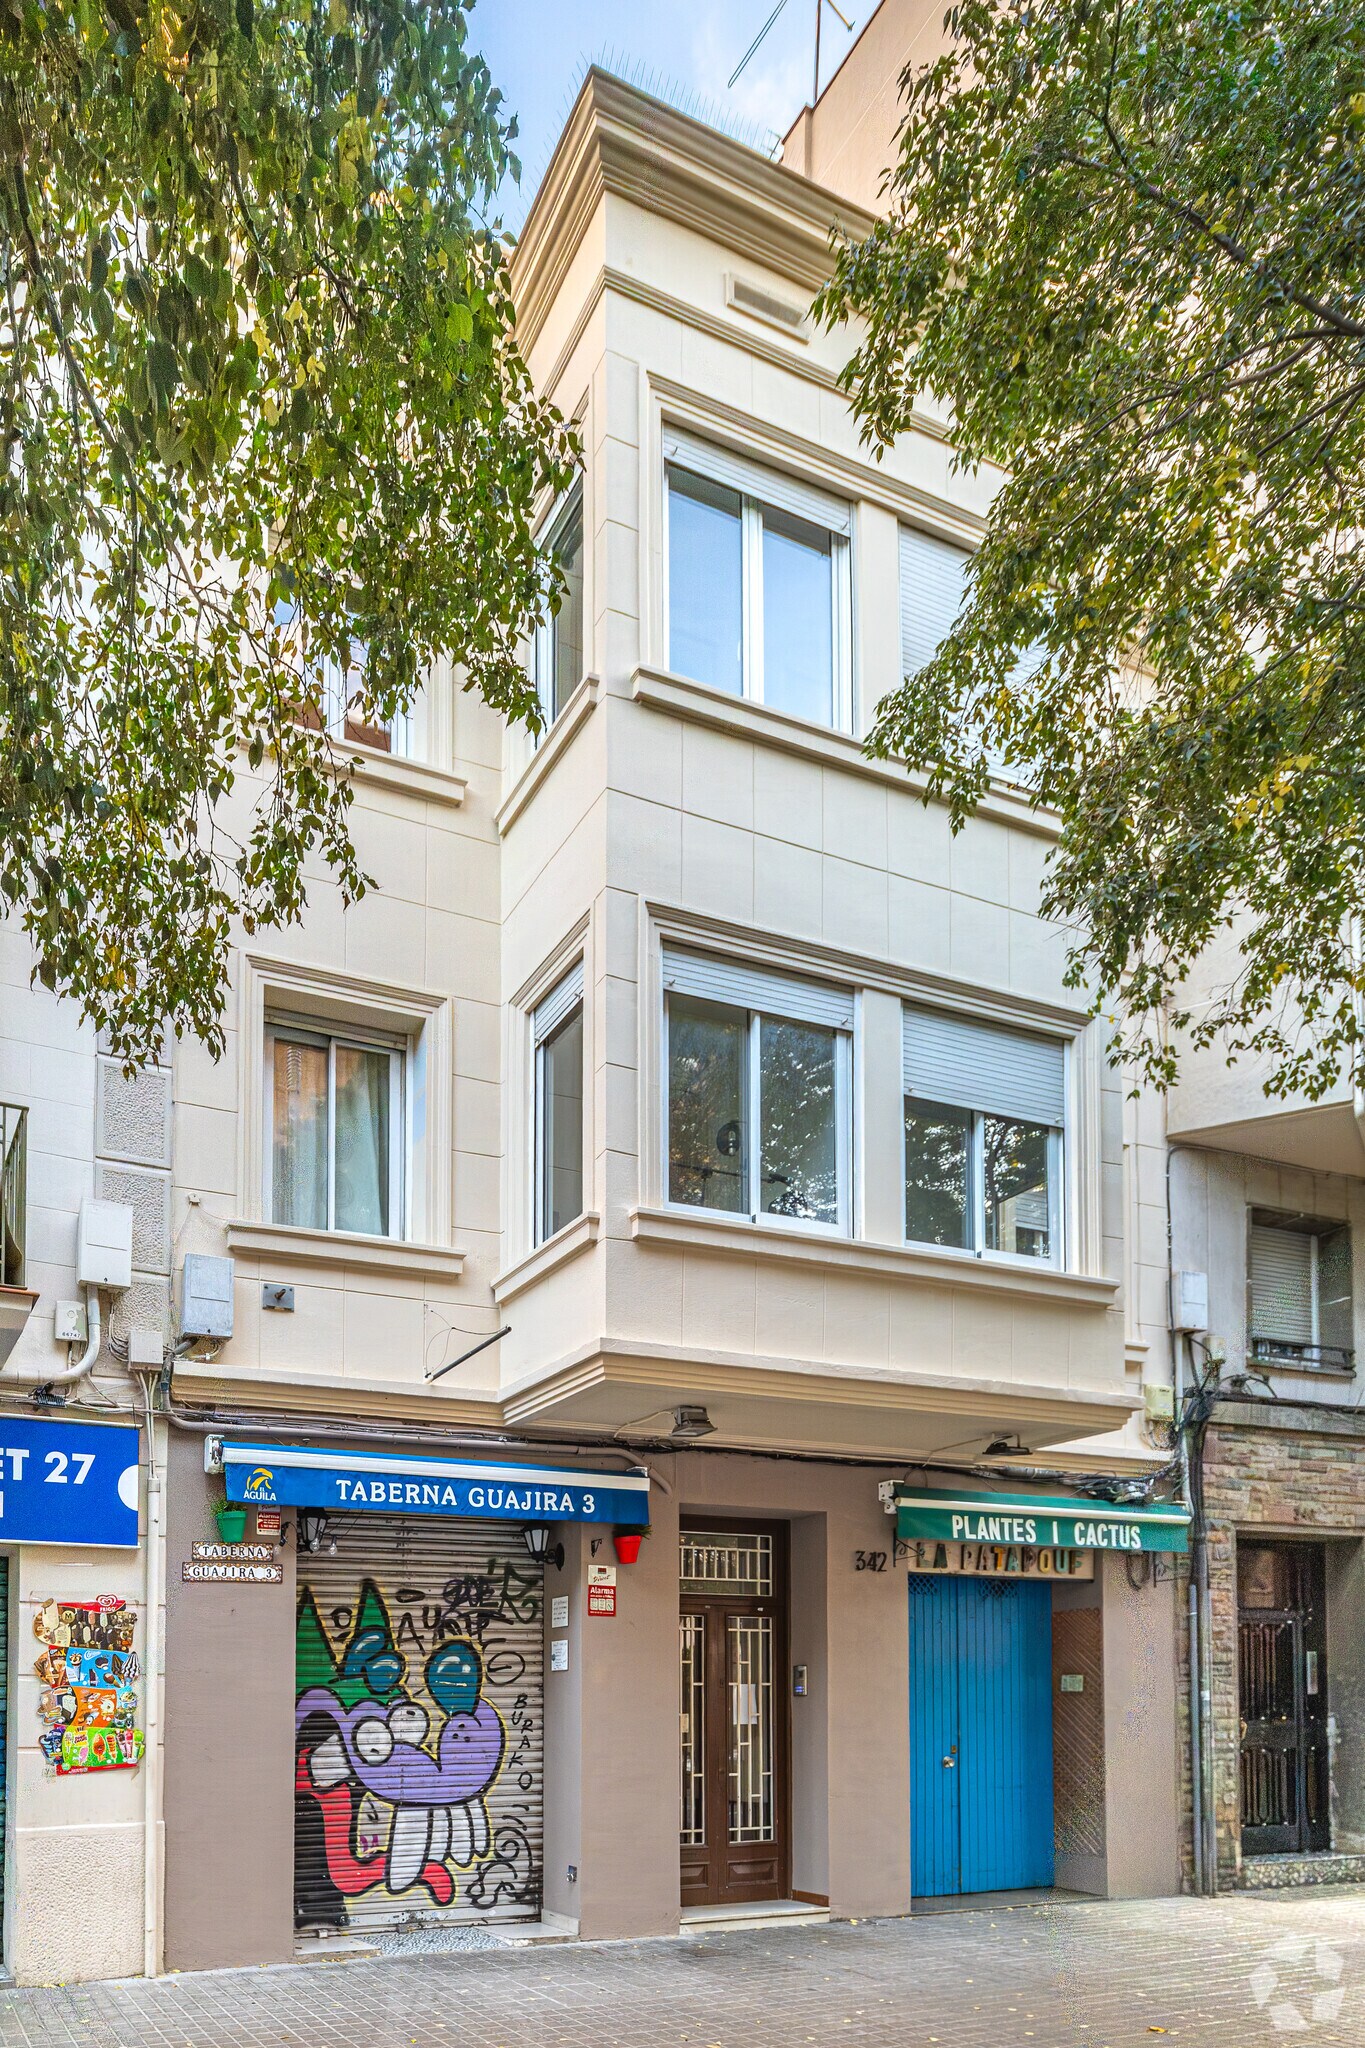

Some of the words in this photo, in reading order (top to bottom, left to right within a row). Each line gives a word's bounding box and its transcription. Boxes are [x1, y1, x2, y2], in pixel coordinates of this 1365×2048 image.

[0, 1448, 29, 1480] T
[44, 1451, 96, 1485] 27
[336, 1479, 457, 1506] TABERNA
[468, 1487, 575, 1512] GUAJIRA
[582, 1494, 595, 1513] 3
[952, 1515, 1036, 1542] PLANTES
[1052, 1520, 1058, 1544] I
[1074, 1522, 1141, 1548] CACTUS
[203, 1546, 264, 1557] TABERNA
[855, 1551, 887, 1572] 342
[916, 1542, 948, 1569] LA
[961, 1544, 1084, 1575] PATAPOUF
[193, 1566, 255, 1578] GUAJIRA
[266, 1568, 272, 1578] 3
[590, 1586, 615, 1595] Alarma
